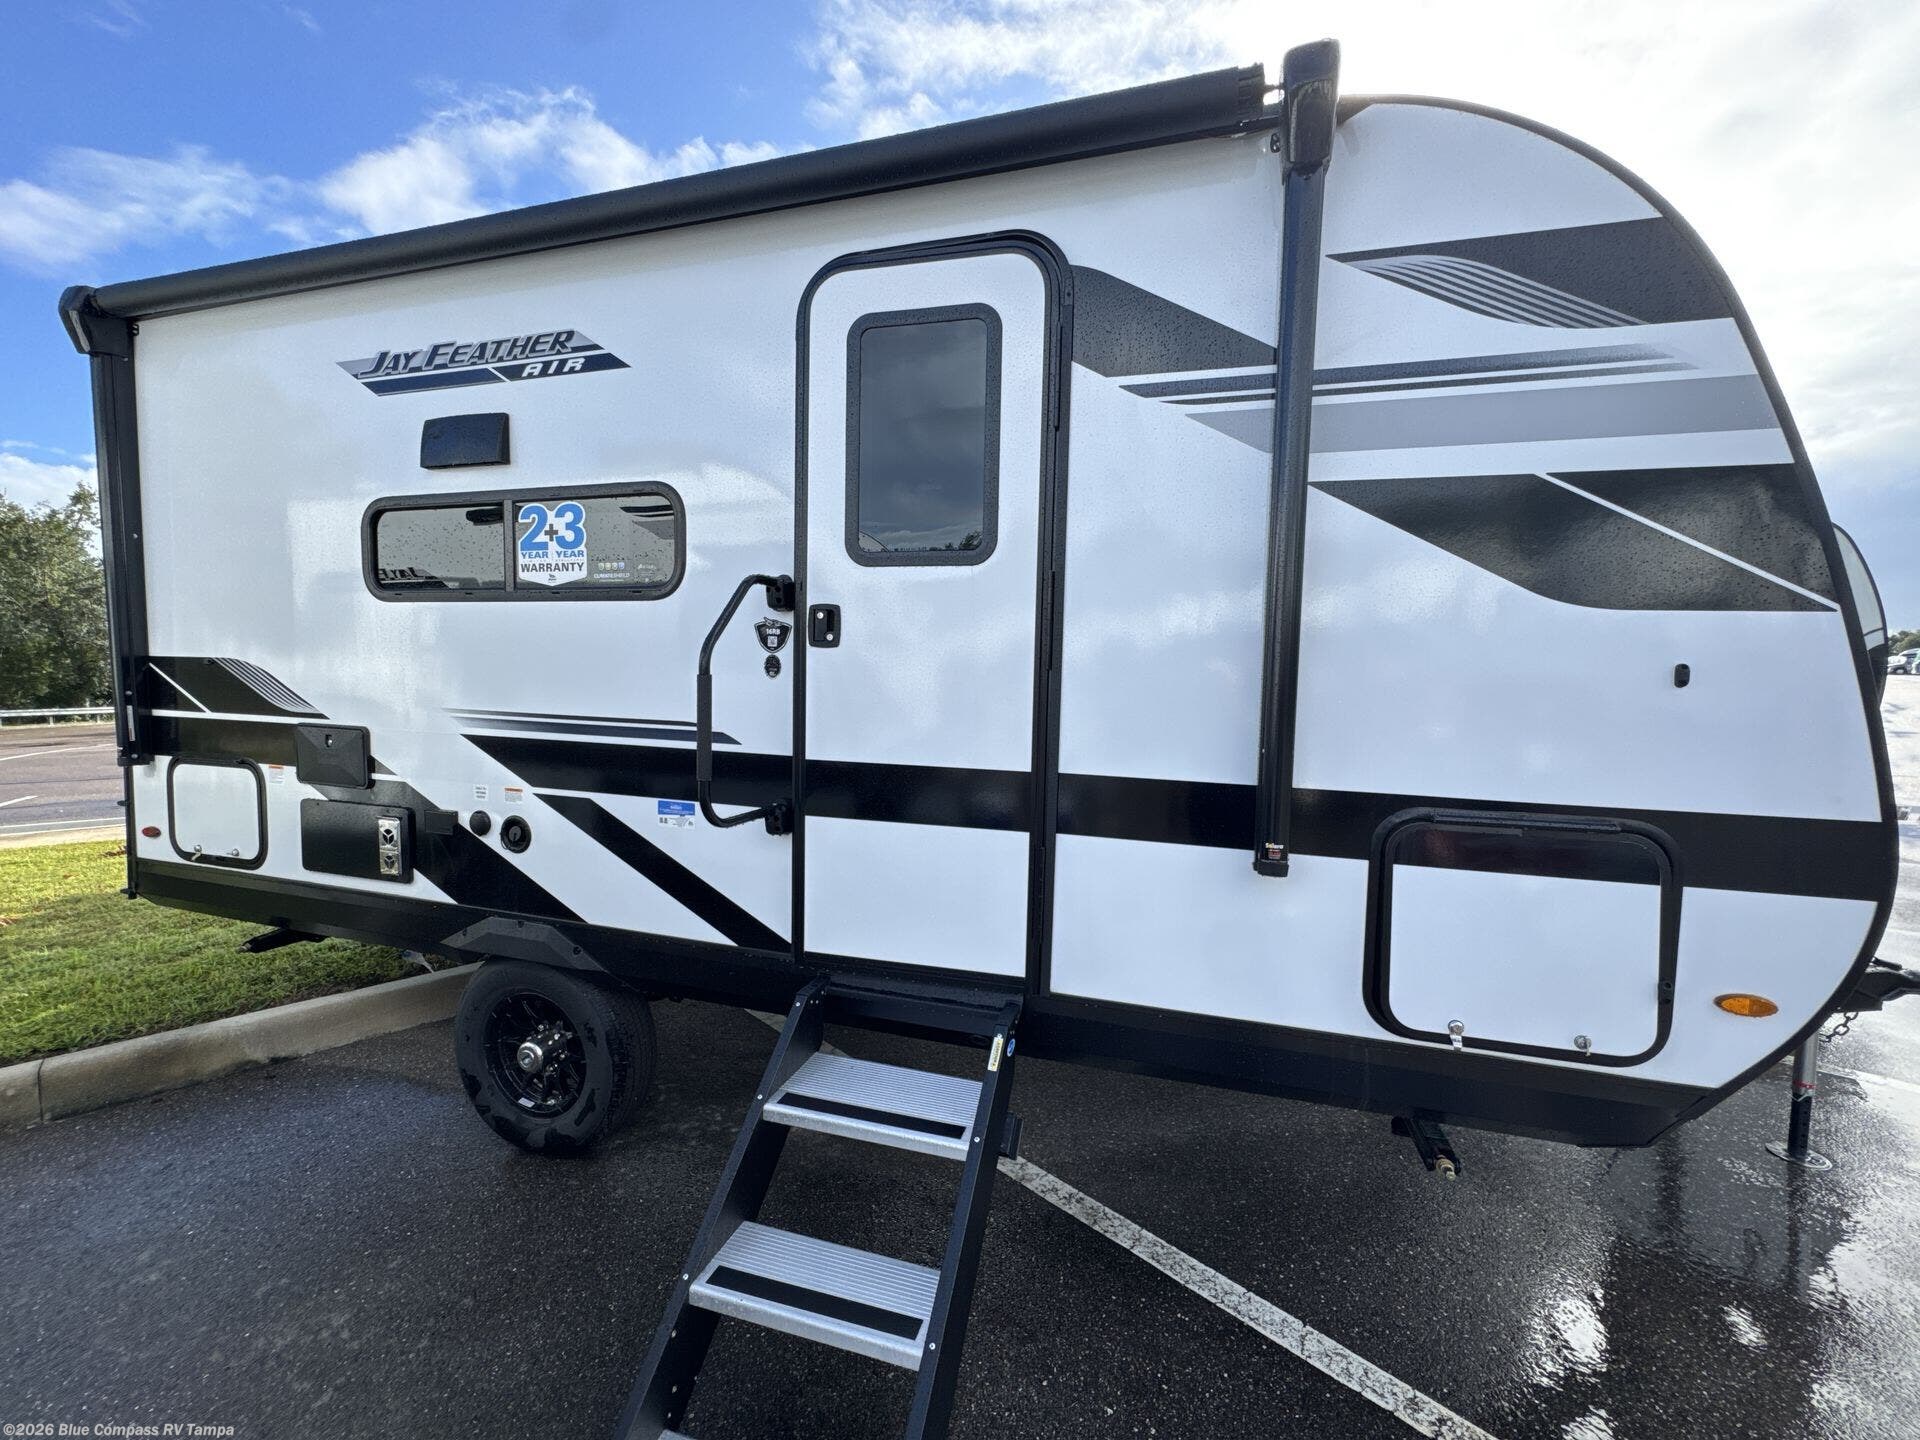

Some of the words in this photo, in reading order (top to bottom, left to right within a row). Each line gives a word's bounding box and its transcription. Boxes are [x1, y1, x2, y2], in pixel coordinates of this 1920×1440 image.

[358, 350, 423, 378] JAY
[422, 330, 576, 371] FEATHER
[521, 357, 586, 378] AIR
[521, 551, 549, 560] YEAR
[556, 550, 585, 558] YEAR
[520, 562, 584, 573] WARRANTY
